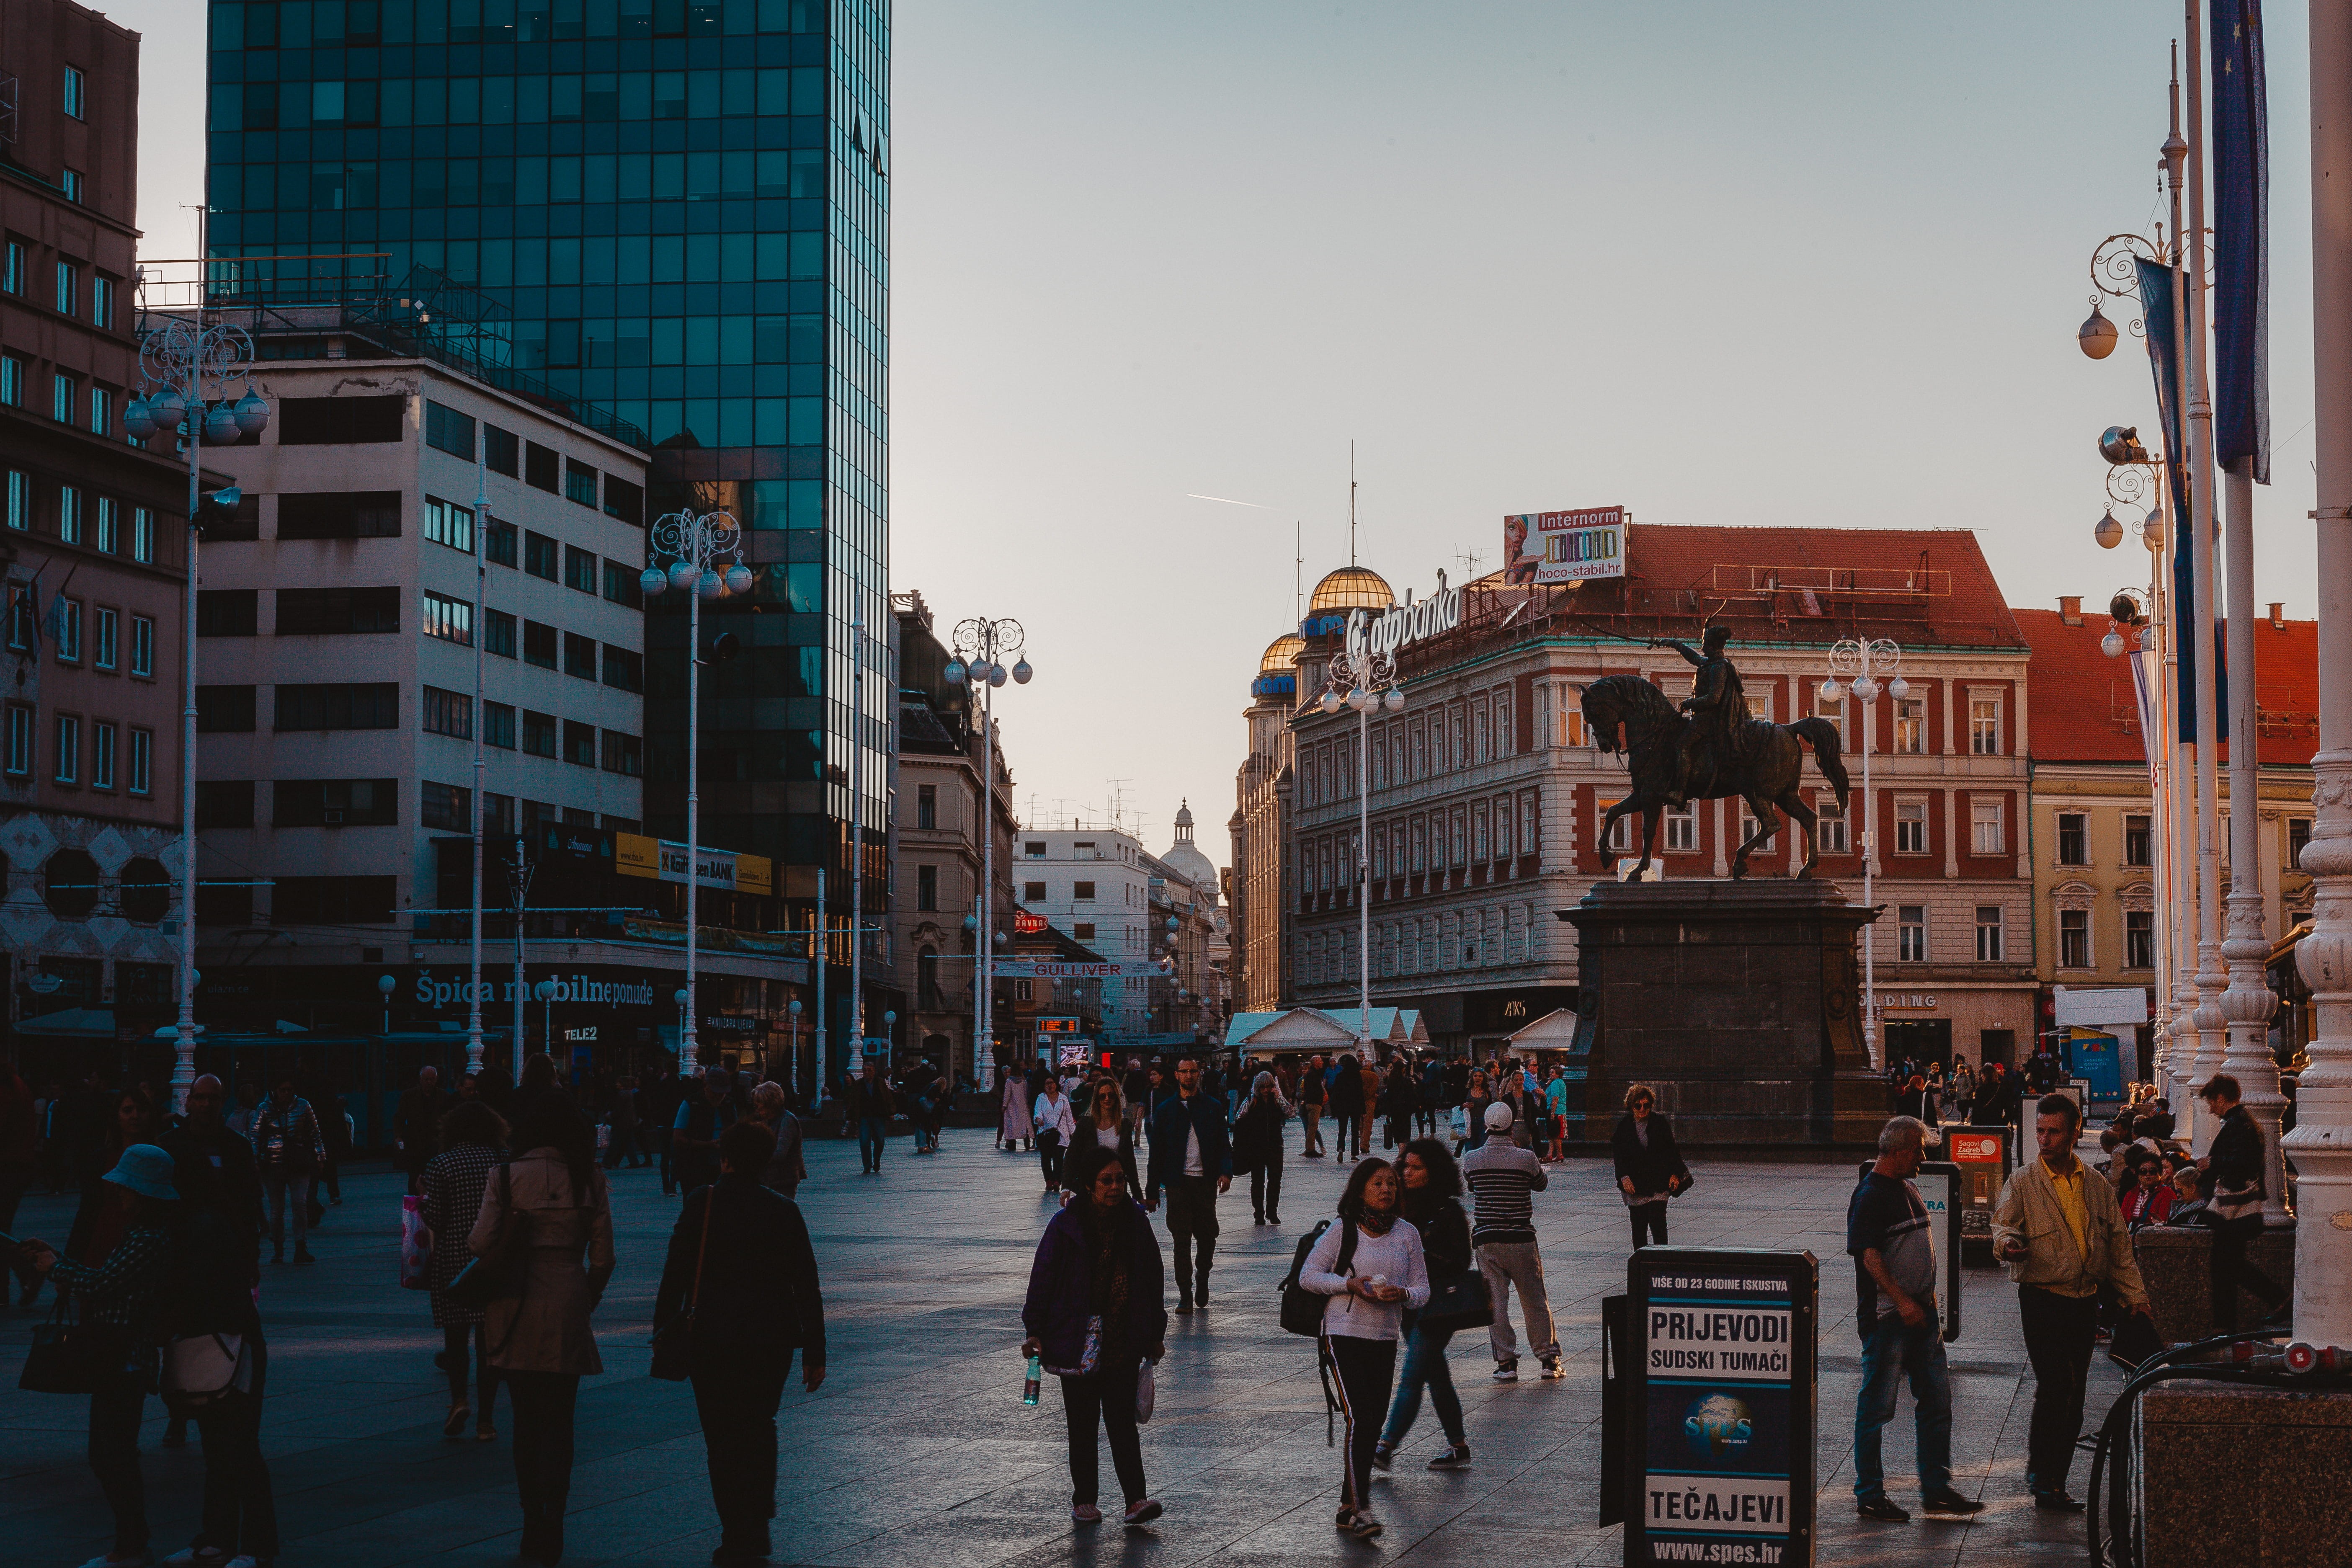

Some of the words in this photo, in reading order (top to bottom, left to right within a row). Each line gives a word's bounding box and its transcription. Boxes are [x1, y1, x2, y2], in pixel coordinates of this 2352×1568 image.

[1542, 511, 1618, 529] Internorm
[1539, 563, 1621, 579] hoco-stabil.hr
[620, 851, 644, 862] www.rba.hr
[671, 854, 709, 877] Raiffsen
[710, 861, 734, 881] BANK
[1035, 964, 1121, 976] GULLIVER
[208, 984, 249, 993] ulaznce
[613, 979, 653, 1009] ponude
[565, 1026, 598, 1040] TELE2
[1959, 1140, 1979, 1148] Sagovi
[1652, 1276, 1672, 1288] VIŠE
[1675, 1278, 1688, 1289] OD
[1690, 1278, 1702, 1289] 23
[1705, 1279, 1741, 1290] GODINE
[1742, 1280, 1788, 1291] ISKUSTVA
[1651, 1312, 1787, 1343] PRIJEVODI
[1651, 1349, 1714, 1369] SUDSKI
[1719, 1349, 1787, 1372] TUMAČI
[1685, 1416, 1751, 1439] SPES
[1650, 1485, 1784, 1524] TEČAJEVI
[1653, 1542, 1782, 1565] www.spes.hr
